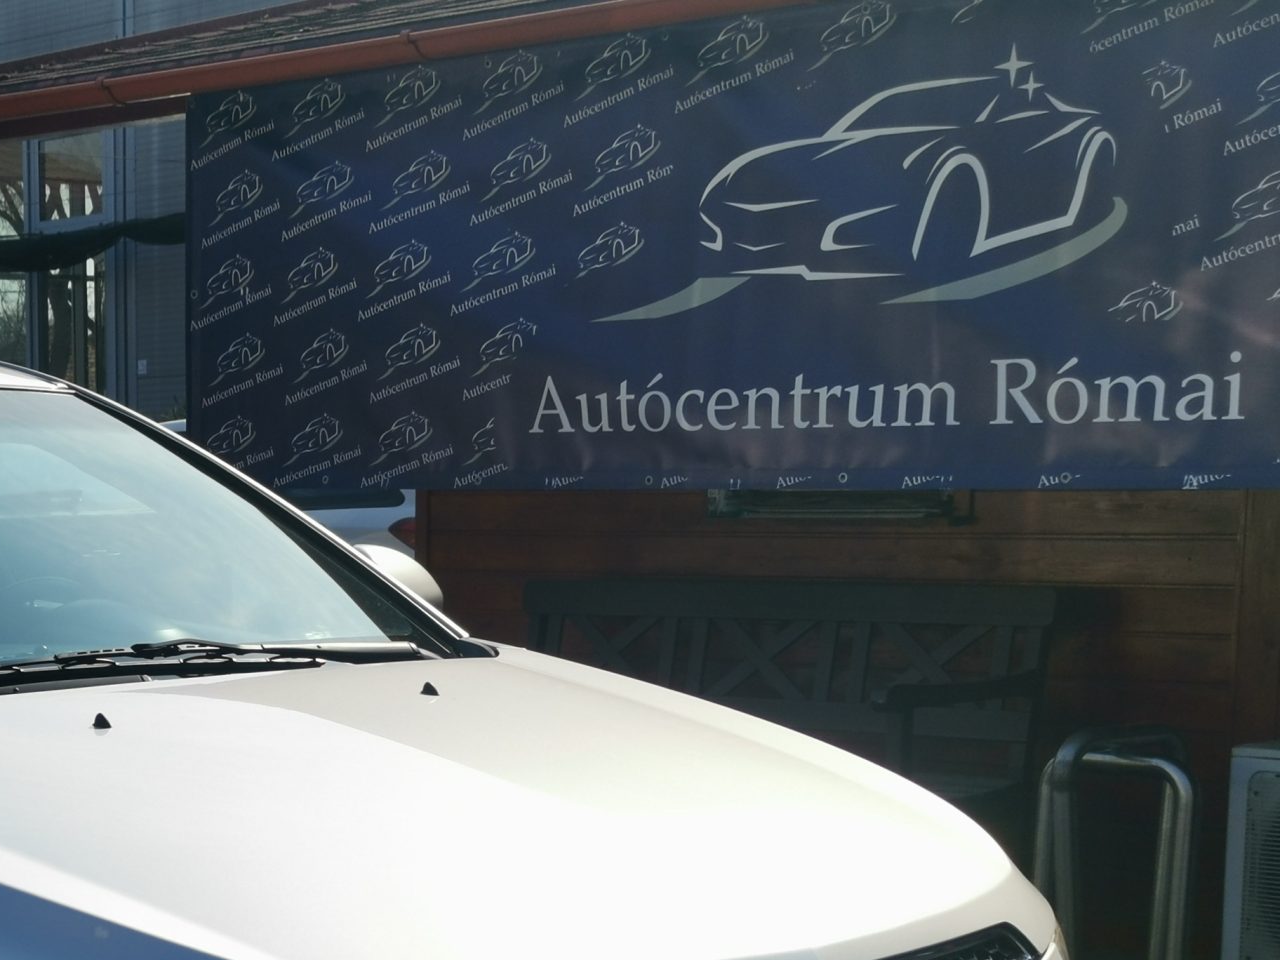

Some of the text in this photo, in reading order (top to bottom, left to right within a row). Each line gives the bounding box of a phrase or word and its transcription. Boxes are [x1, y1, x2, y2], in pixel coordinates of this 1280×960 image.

[1163, 0, 1214, 21] Róma
[564, 64, 674, 128] Autócentrum Római
[675, 48, 795, 114] Autócentrum Római
[272, 108, 365, 161] Autócentrum Római
[366, 95, 463, 152] Autócentrum Római
[462, 80, 564, 141] Autócentrum Római
[1173, 98, 1222, 130] Római
[190, 120, 275, 171] Autócentrum Római
[281, 190, 372, 242] Autócentrum Római
[368, 181, 471, 235] Autócentrum Római
[470, 169, 573, 226] Autócentrum Római
[201, 199, 281, 249] Autócentrum Római
[190, 284, 272, 332] Autócentrum Római
[273, 277, 357, 328] Autócentrum Római
[357, 272, 451, 322] Autócentrum Római
[450, 264, 556, 317] Autócentrum Római
[201, 363, 284, 409] Autócentrum Római
[284, 360, 368, 406] Autócentrum Római
[369, 355, 461, 404] Autócentrum Római
[528, 351, 1245, 434] Autócentrum Római
[246, 446, 274, 466] Római
[273, 460, 331, 489] Autócentrum
[333, 444, 361, 464] Római
[361, 444, 454, 488] Autócentrum Római
